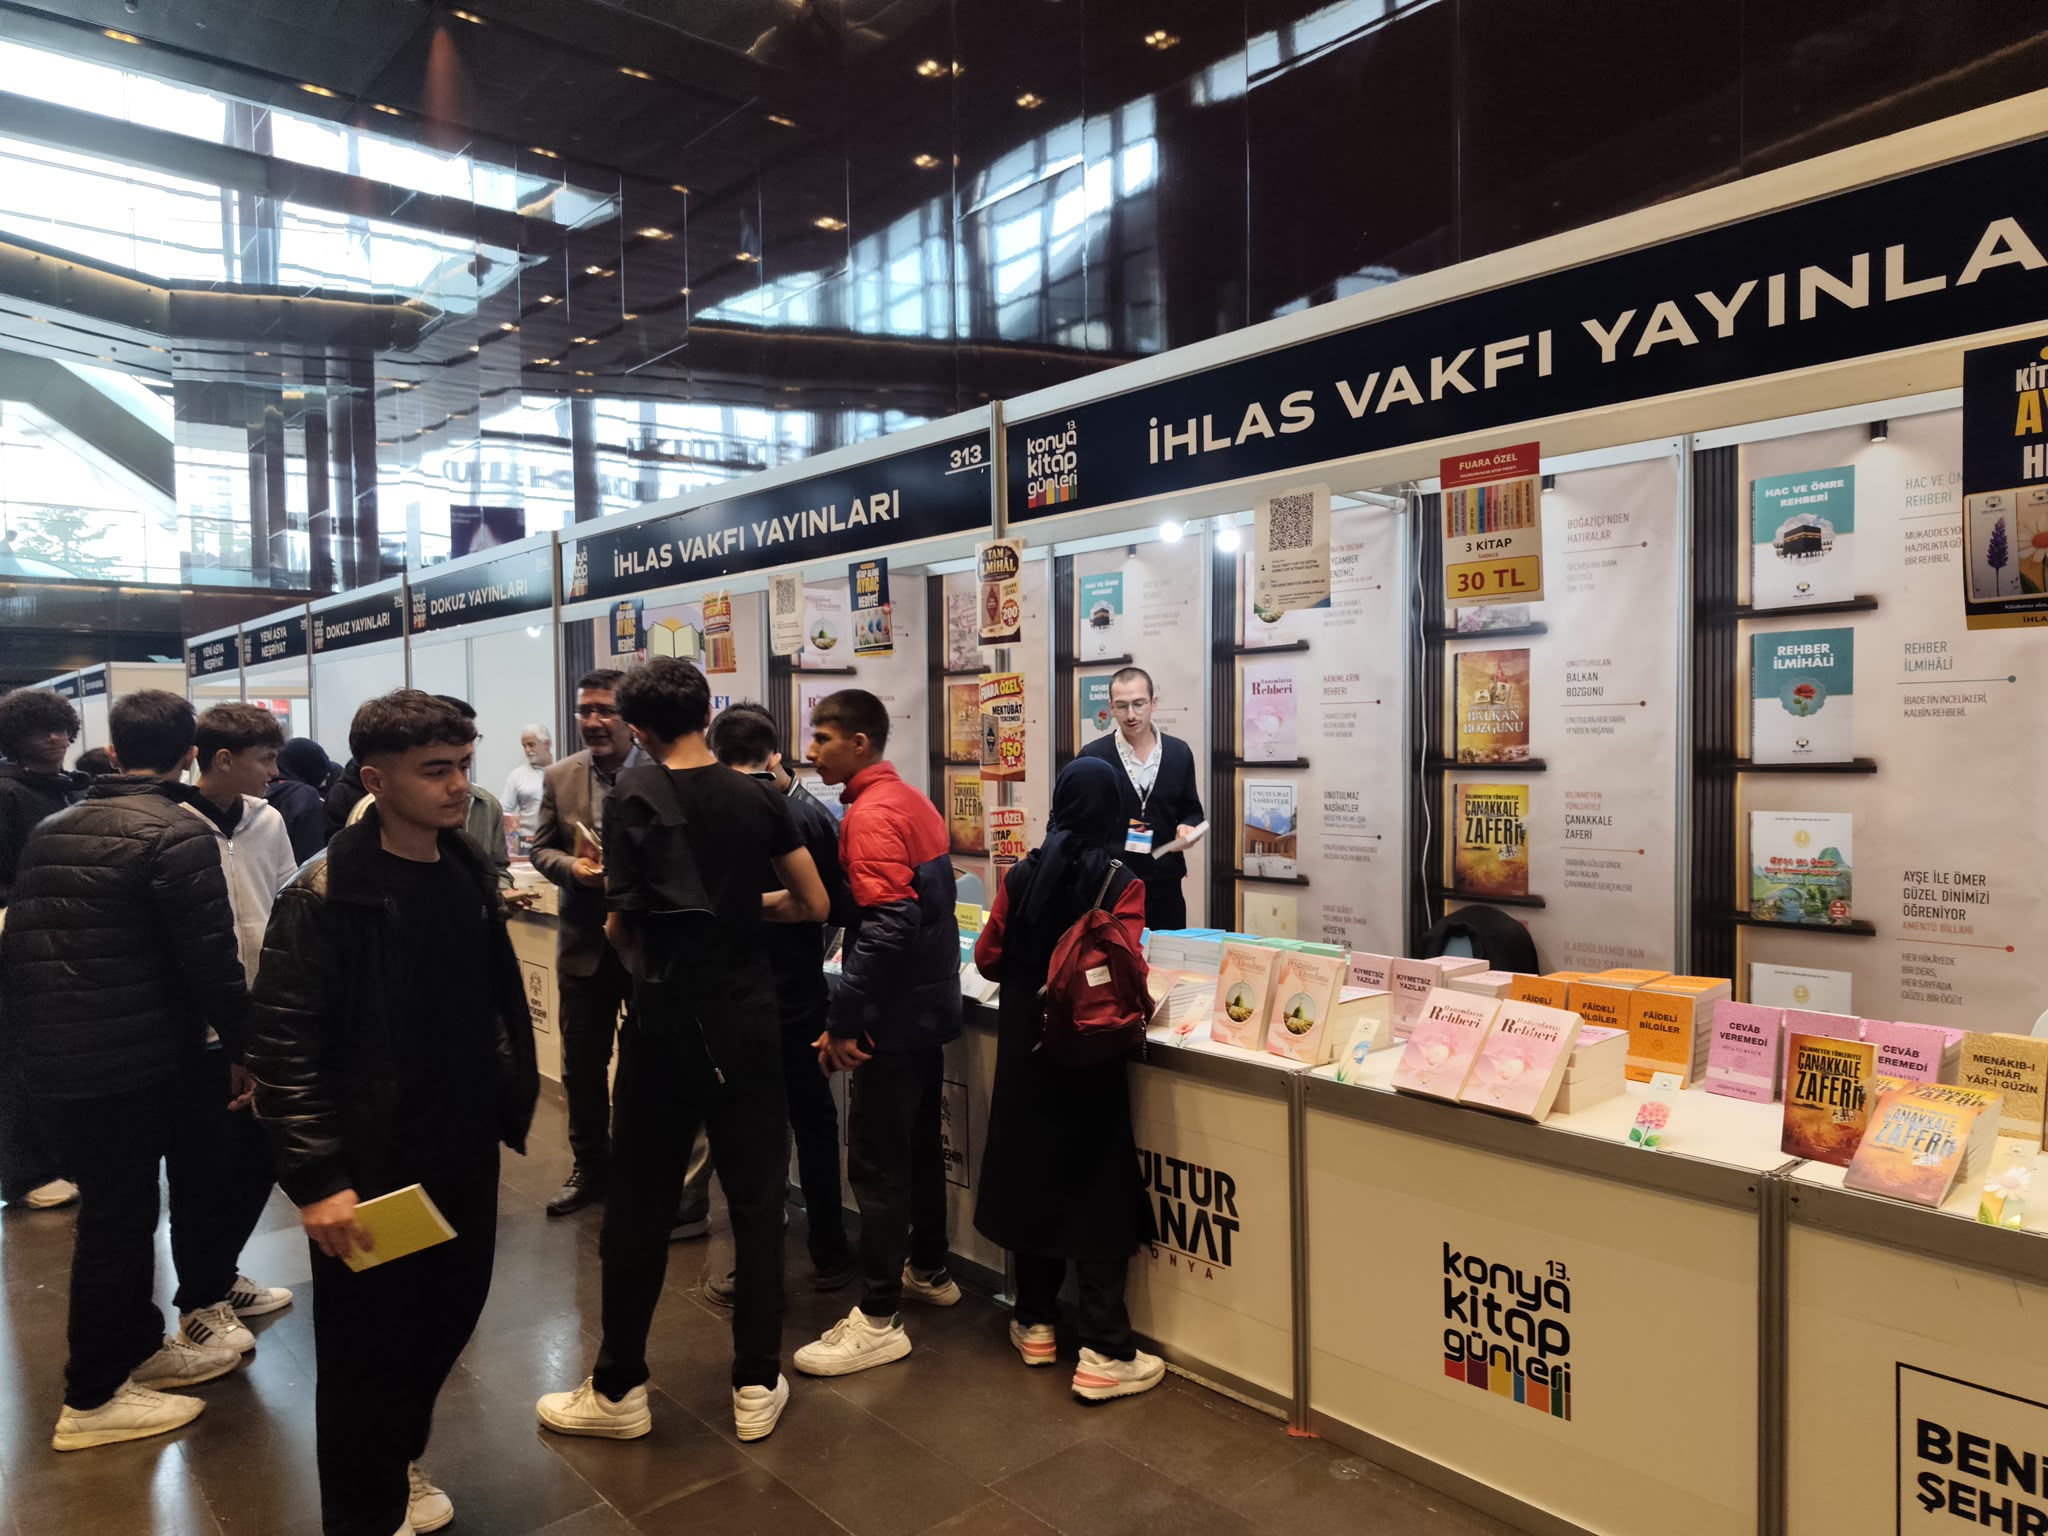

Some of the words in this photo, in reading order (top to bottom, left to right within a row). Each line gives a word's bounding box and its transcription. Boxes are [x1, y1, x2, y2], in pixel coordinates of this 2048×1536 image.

[1149, 389, 1316, 465] İHLAS
[1335, 329, 1552, 419] VAKFI
[1027, 430, 1077, 456] konya
[950, 444, 983, 470] 313
[1027, 450, 1077, 479] kitap
[1459, 459, 1491, 471] FUARA
[1494, 453, 1518, 465] ÖZEL
[2023, 443, 2048, 480] H
[1027, 470, 1078, 500] günleri
[1765, 486, 1790, 498] HAC
[1793, 484, 1808, 494] VE
[1811, 479, 1845, 493] ÖMRE
[1780, 493, 1829, 508] REHBERİ
[1905, 489, 1952, 508] REHBERİ
[1567, 511, 1630, 530] BOĞAZİÇİ'NDEN
[613, 543, 672, 579] İHLAS
[678, 526, 746, 565] VAKFI
[753, 489, 901, 548] YAYINLARI
[1567, 529, 1612, 545] HATIRALAR
[1951, 526, 1962, 536] YO
[1465, 542, 1472, 553] 3
[1476, 537, 1513, 551] KİTAP
[1949, 538, 1962, 550] GÜ
[987, 547, 1004, 561] TAM
[1330, 554, 1359, 567] YGAMBER
[1457, 571, 1486, 592] 30
[1493, 567, 1526, 588] TL
[430, 596, 466, 616] DOKUZ
[468, 578, 528, 608] YAYINLARI
[1002, 606, 1018, 620] 200
[326, 621, 350, 639] DOKUZ
[351, 611, 390, 634] YAYINLARI
[1777, 643, 1831, 657] REHBER
[1904, 641, 1948, 655] REHBER
[1773, 652, 1834, 670] İLMİHÂLİ
[1904, 656, 1954, 673] İLMİHÂLİ
[1566, 672, 1599, 683] BALKAN
[1000, 678, 1020, 696] ÖZEL
[1251, 681, 1293, 696] Rehberi
[1566, 686, 1604, 698] BOZGUNU
[1467, 708, 1520, 722] BALKAN
[1463, 720, 1524, 735] BOZGUNU
[1000, 742, 1022, 758] 150
[1006, 756, 1017, 766] TL
[1003, 811, 1024, 825] ÖZEL
[1565, 814, 1613, 827] ÇANAKKALE
[1465, 816, 1520, 846] ZAFERİ
[1565, 827, 1593, 840] ZAFERİ
[1000, 840, 1014, 855] 30
[1014, 840, 1026, 853] TL
[1903, 871, 1930, 885] AYŞE
[1933, 869, 1950, 885] İLE
[1953, 870, 1987, 887] ÖMER
[1903, 887, 1938, 902] GÜZEL
[1941, 888, 1990, 905] DİNİMİZİ
[1903, 902, 1967, 921] ÖĞRENİYOR
[1356, 975, 1381, 986] YAZILAR
[1400, 982, 1427, 993] YAZILAR
[1428, 1005, 1481, 1029] Rehberi
[1501, 1018, 1558, 1043] Rehberi
[1639, 1021, 1680, 1034] BİLGİLER
[1729, 1021, 1761, 1034] CEVÂB
[1719, 1031, 1768, 1047] VEREMEDİ
[1882, 1044, 1920, 1058] CEVÂB
[1877, 1055, 1928, 1073] EREMEDİ
[1795, 1070, 1861, 1111] ZAFERİ
[1138, 1148, 1240, 1219] ÜLTÜR
[1151, 1247, 1214, 1281] ONYA
[1545, 1259, 1571, 1283] 13.
[1443, 1241, 1571, 1315] konya
[1444, 1277, 1571, 1360] kitap
[1443, 1327, 1571, 1394] günleri
